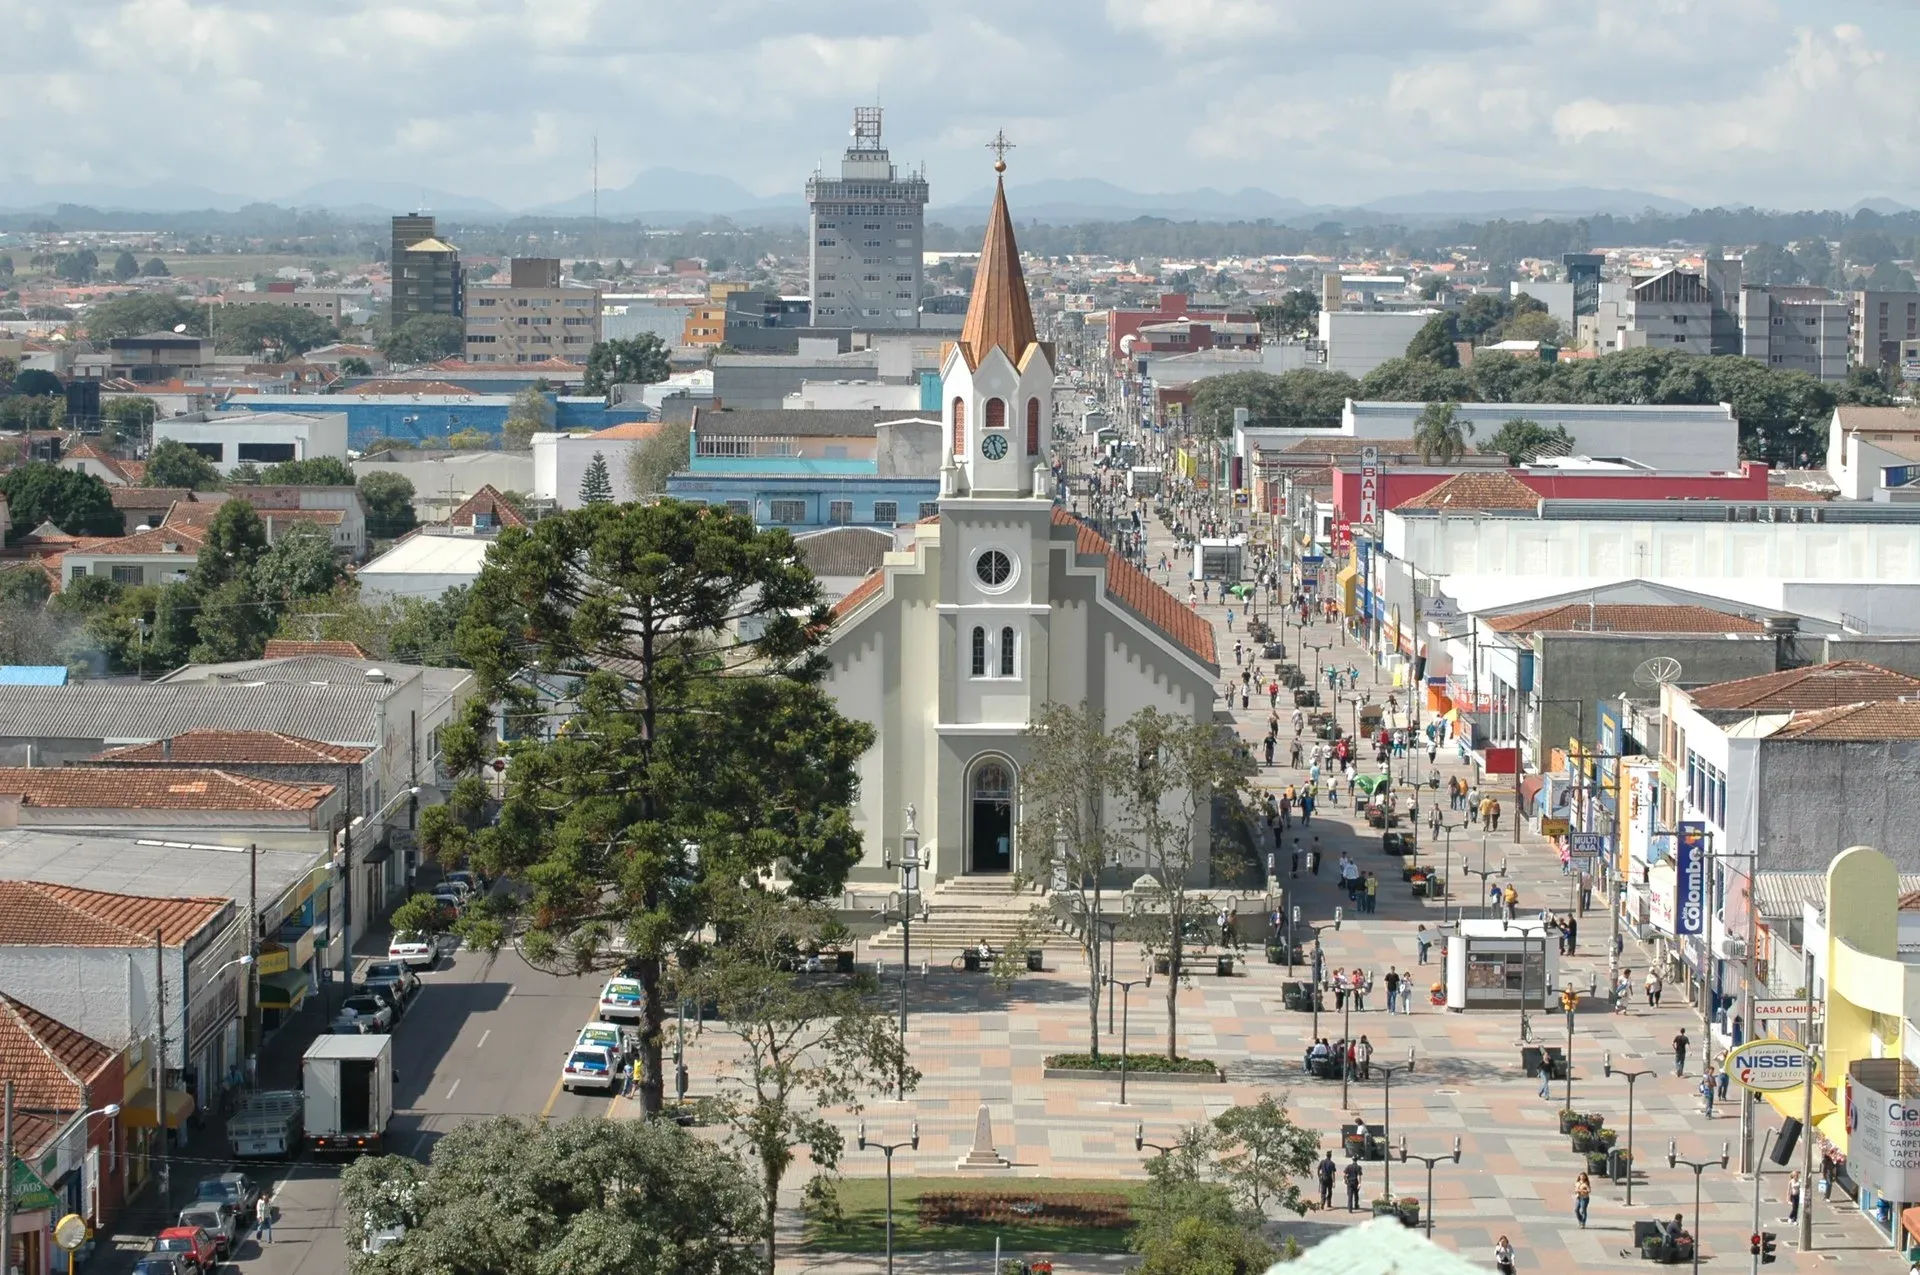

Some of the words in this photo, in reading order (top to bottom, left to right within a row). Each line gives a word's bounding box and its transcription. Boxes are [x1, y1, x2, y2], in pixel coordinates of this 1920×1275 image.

[1362, 467, 1376, 523] BAHIA
[1574, 836, 1597, 844] MULTI
[1684, 848, 1701, 931] Colombo
[1756, 1006, 1783, 1014] CASA
[1889, 1103, 1920, 1121] Cie
